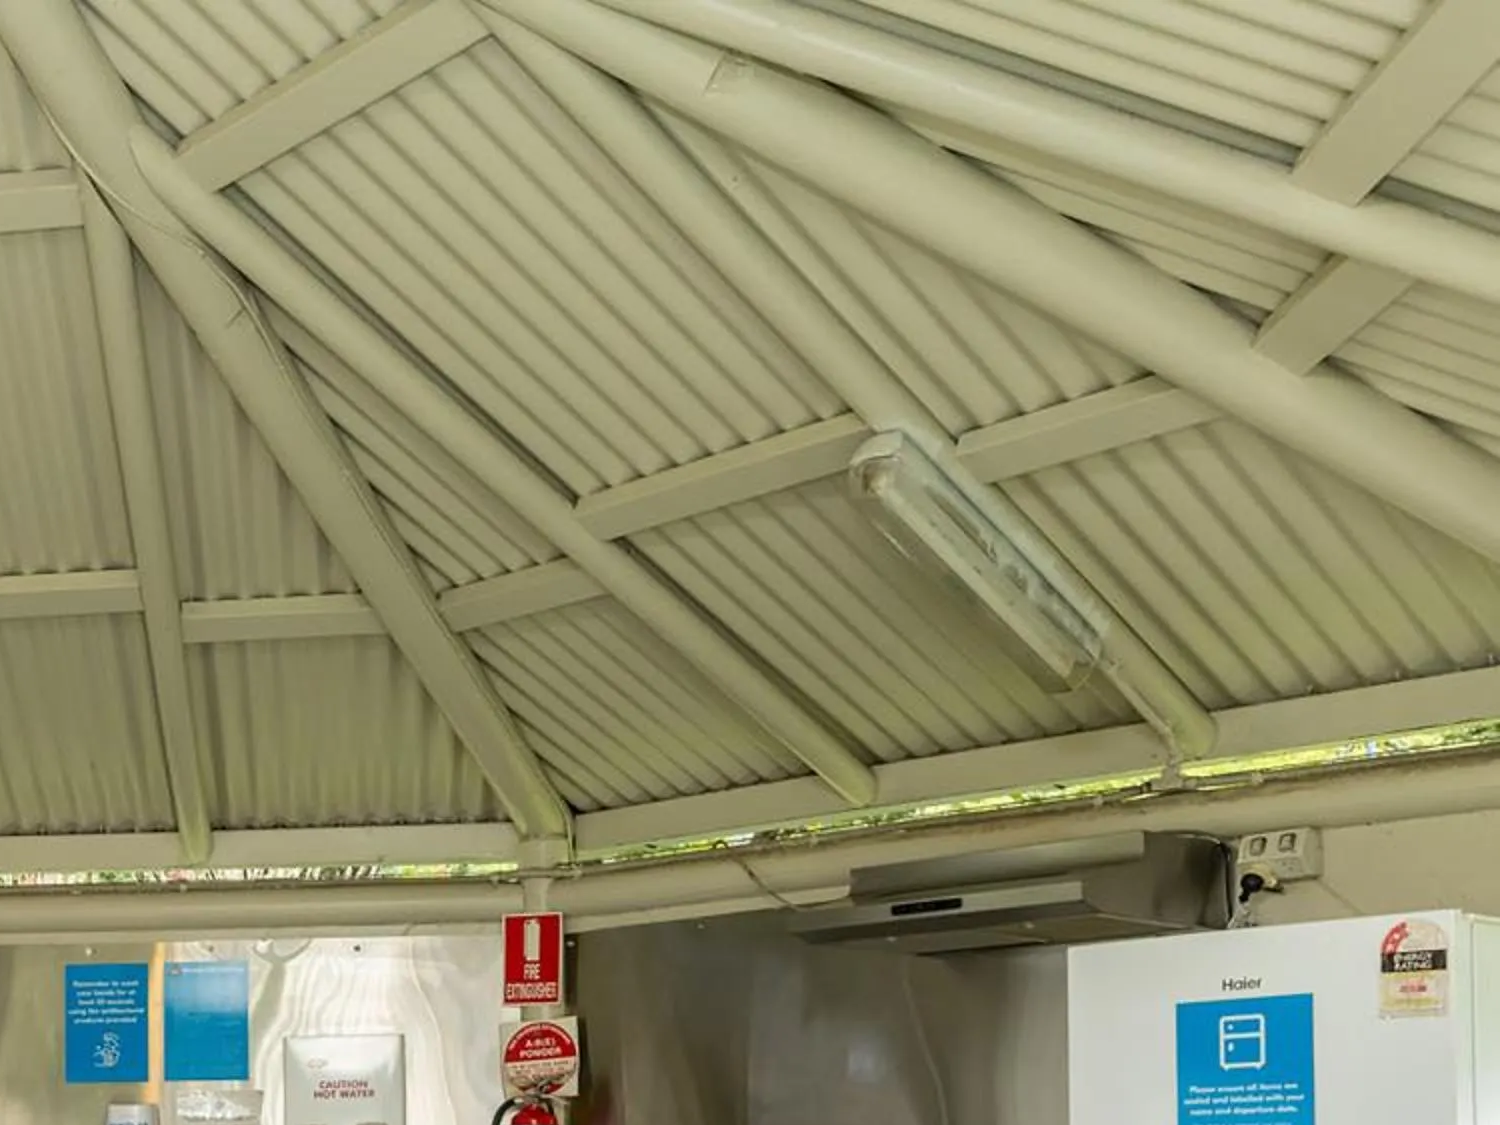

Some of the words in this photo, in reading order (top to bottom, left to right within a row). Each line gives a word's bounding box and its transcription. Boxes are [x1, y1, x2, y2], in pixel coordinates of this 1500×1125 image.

[523, 962, 540, 980] FIRE
[1221, 976, 1262, 991] Haier
[318, 1079, 369, 1090] CAUTION
[313, 1089, 337, 1100] HOT
[339, 1089, 376, 1099] WATER
